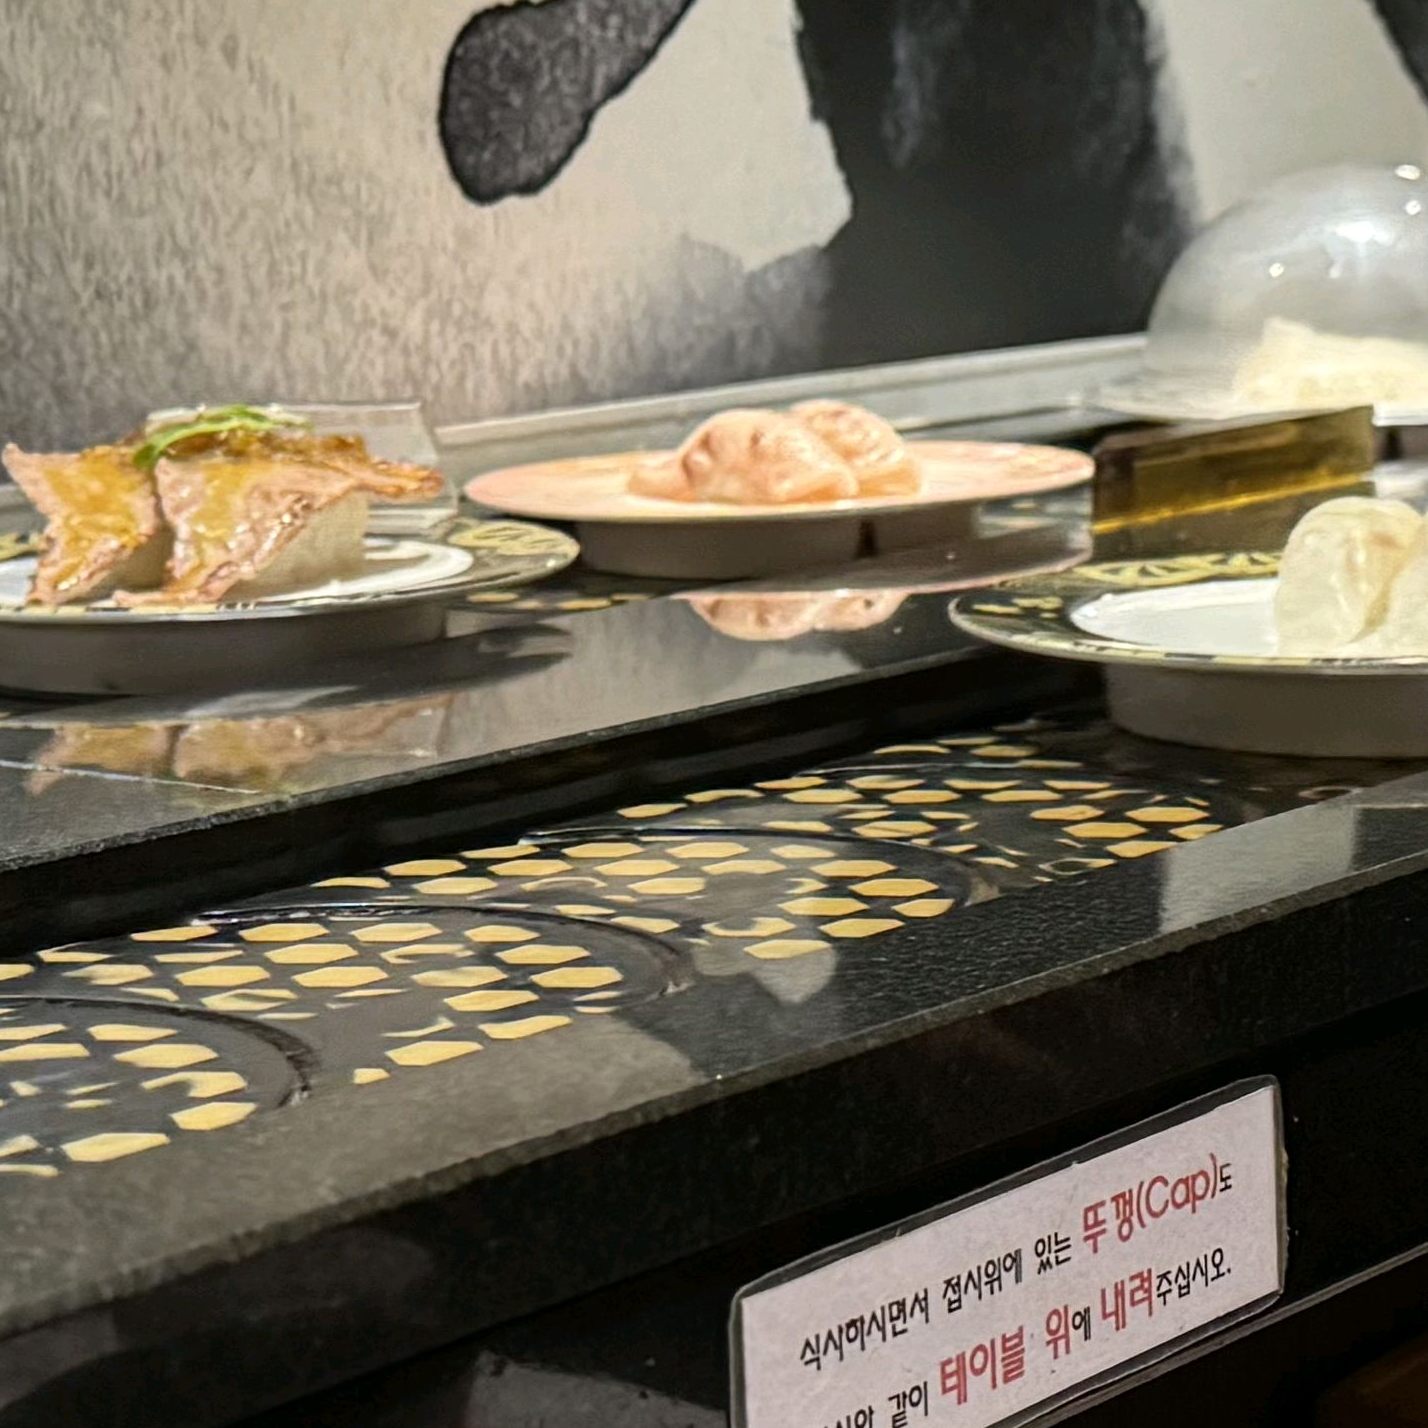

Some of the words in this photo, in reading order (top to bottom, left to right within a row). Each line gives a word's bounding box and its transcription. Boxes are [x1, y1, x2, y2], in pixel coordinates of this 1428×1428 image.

[800, 1287, 930, 1370] 식사하시면서
[943, 1248, 1023, 1315] 접시위에
[1033, 1231, 1072, 1275] 있는
[1082, 1153, 1233, 1254] 뚜껑(Cap)도
[939, 1326, 1026, 1406] 테이블
[1044, 1304, 1092, 1361] 위에
[1100, 1246, 1231, 1332] 내려주십시오.
